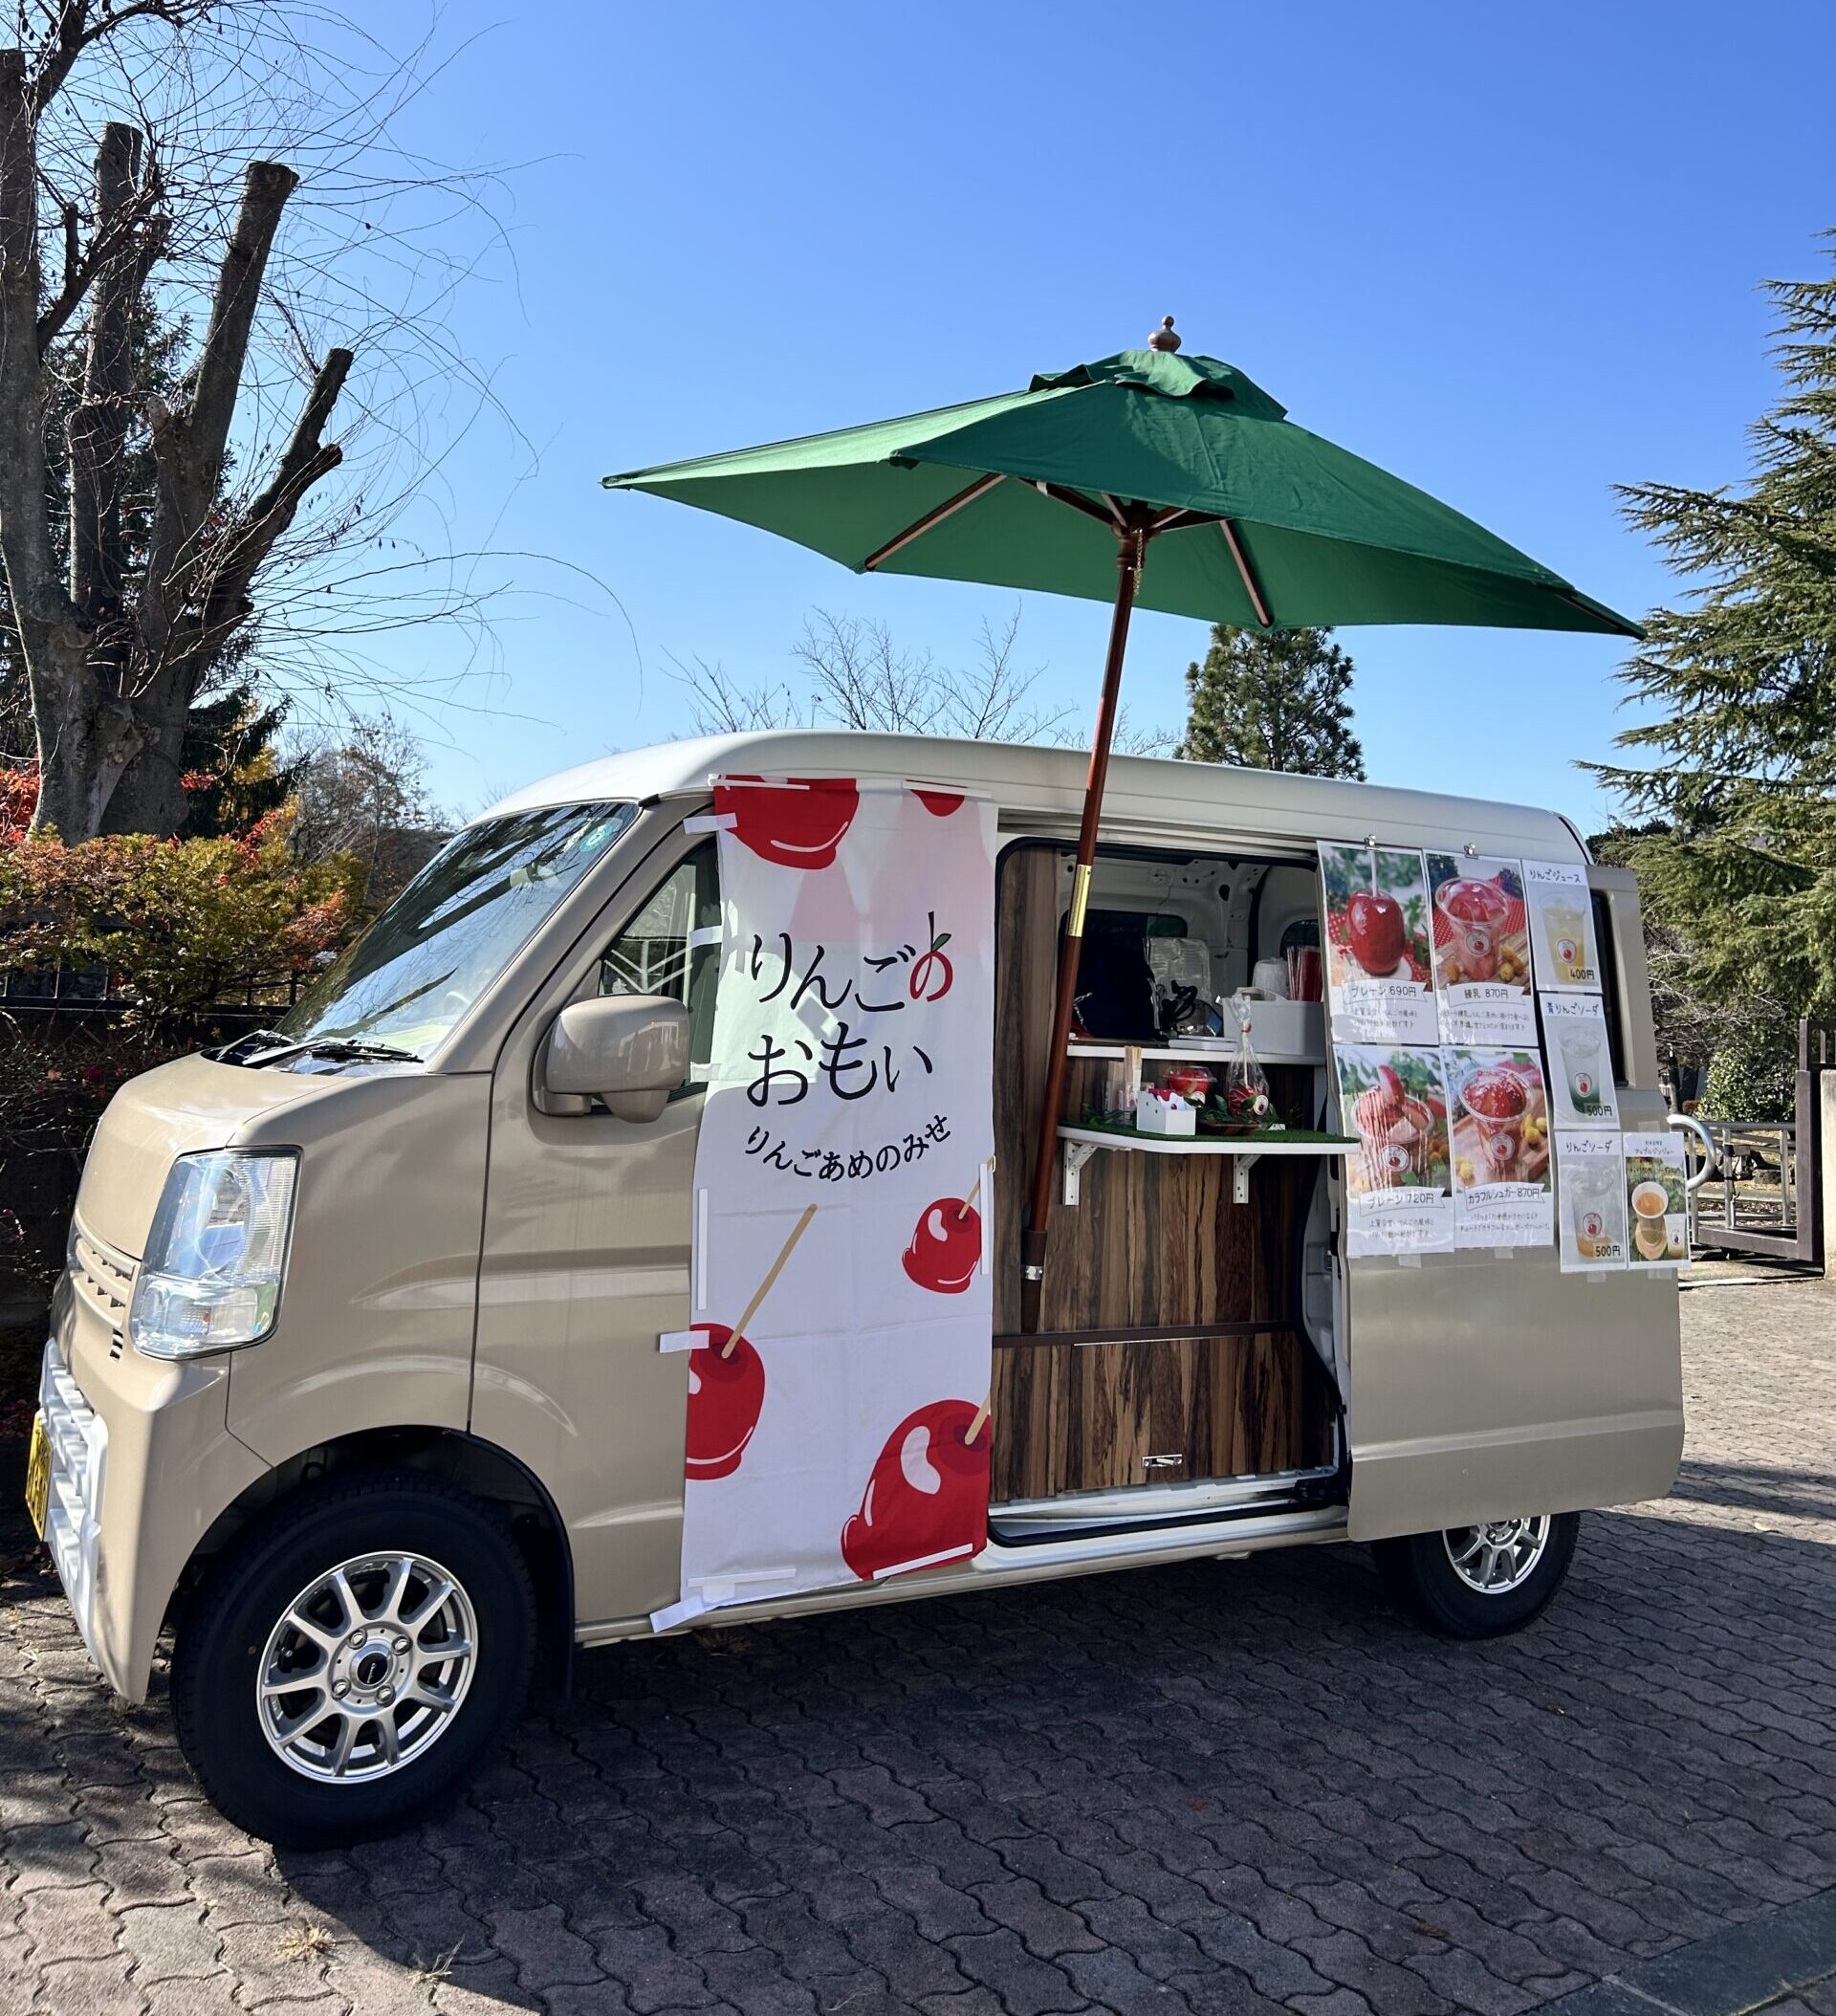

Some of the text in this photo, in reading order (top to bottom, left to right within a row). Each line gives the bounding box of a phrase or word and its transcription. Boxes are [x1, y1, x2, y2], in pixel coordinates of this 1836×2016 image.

[1529, 868, 1583, 884] りんごジュース
[751, 912, 954, 1013] りんごの
[1569, 968, 1595, 980] 400円
[1389, 985, 1416, 997] 690円
[1464, 988, 1509, 999] 練乳 870円
[1545, 1002, 1600, 1018] 青りんごソーダ
[746, 1021, 933, 1107] おもい
[1585, 1105, 1613, 1117] 500円
[744, 1115, 952, 1182] りんごあめのみせ
[1565, 1141, 1613, 1154] りんごソーダ
[1407, 1193, 1434, 1204] 720円
[1468, 1186, 1540, 1205] カラフルシュガー 870円
[1595, 1246, 1621, 1258] 500円
